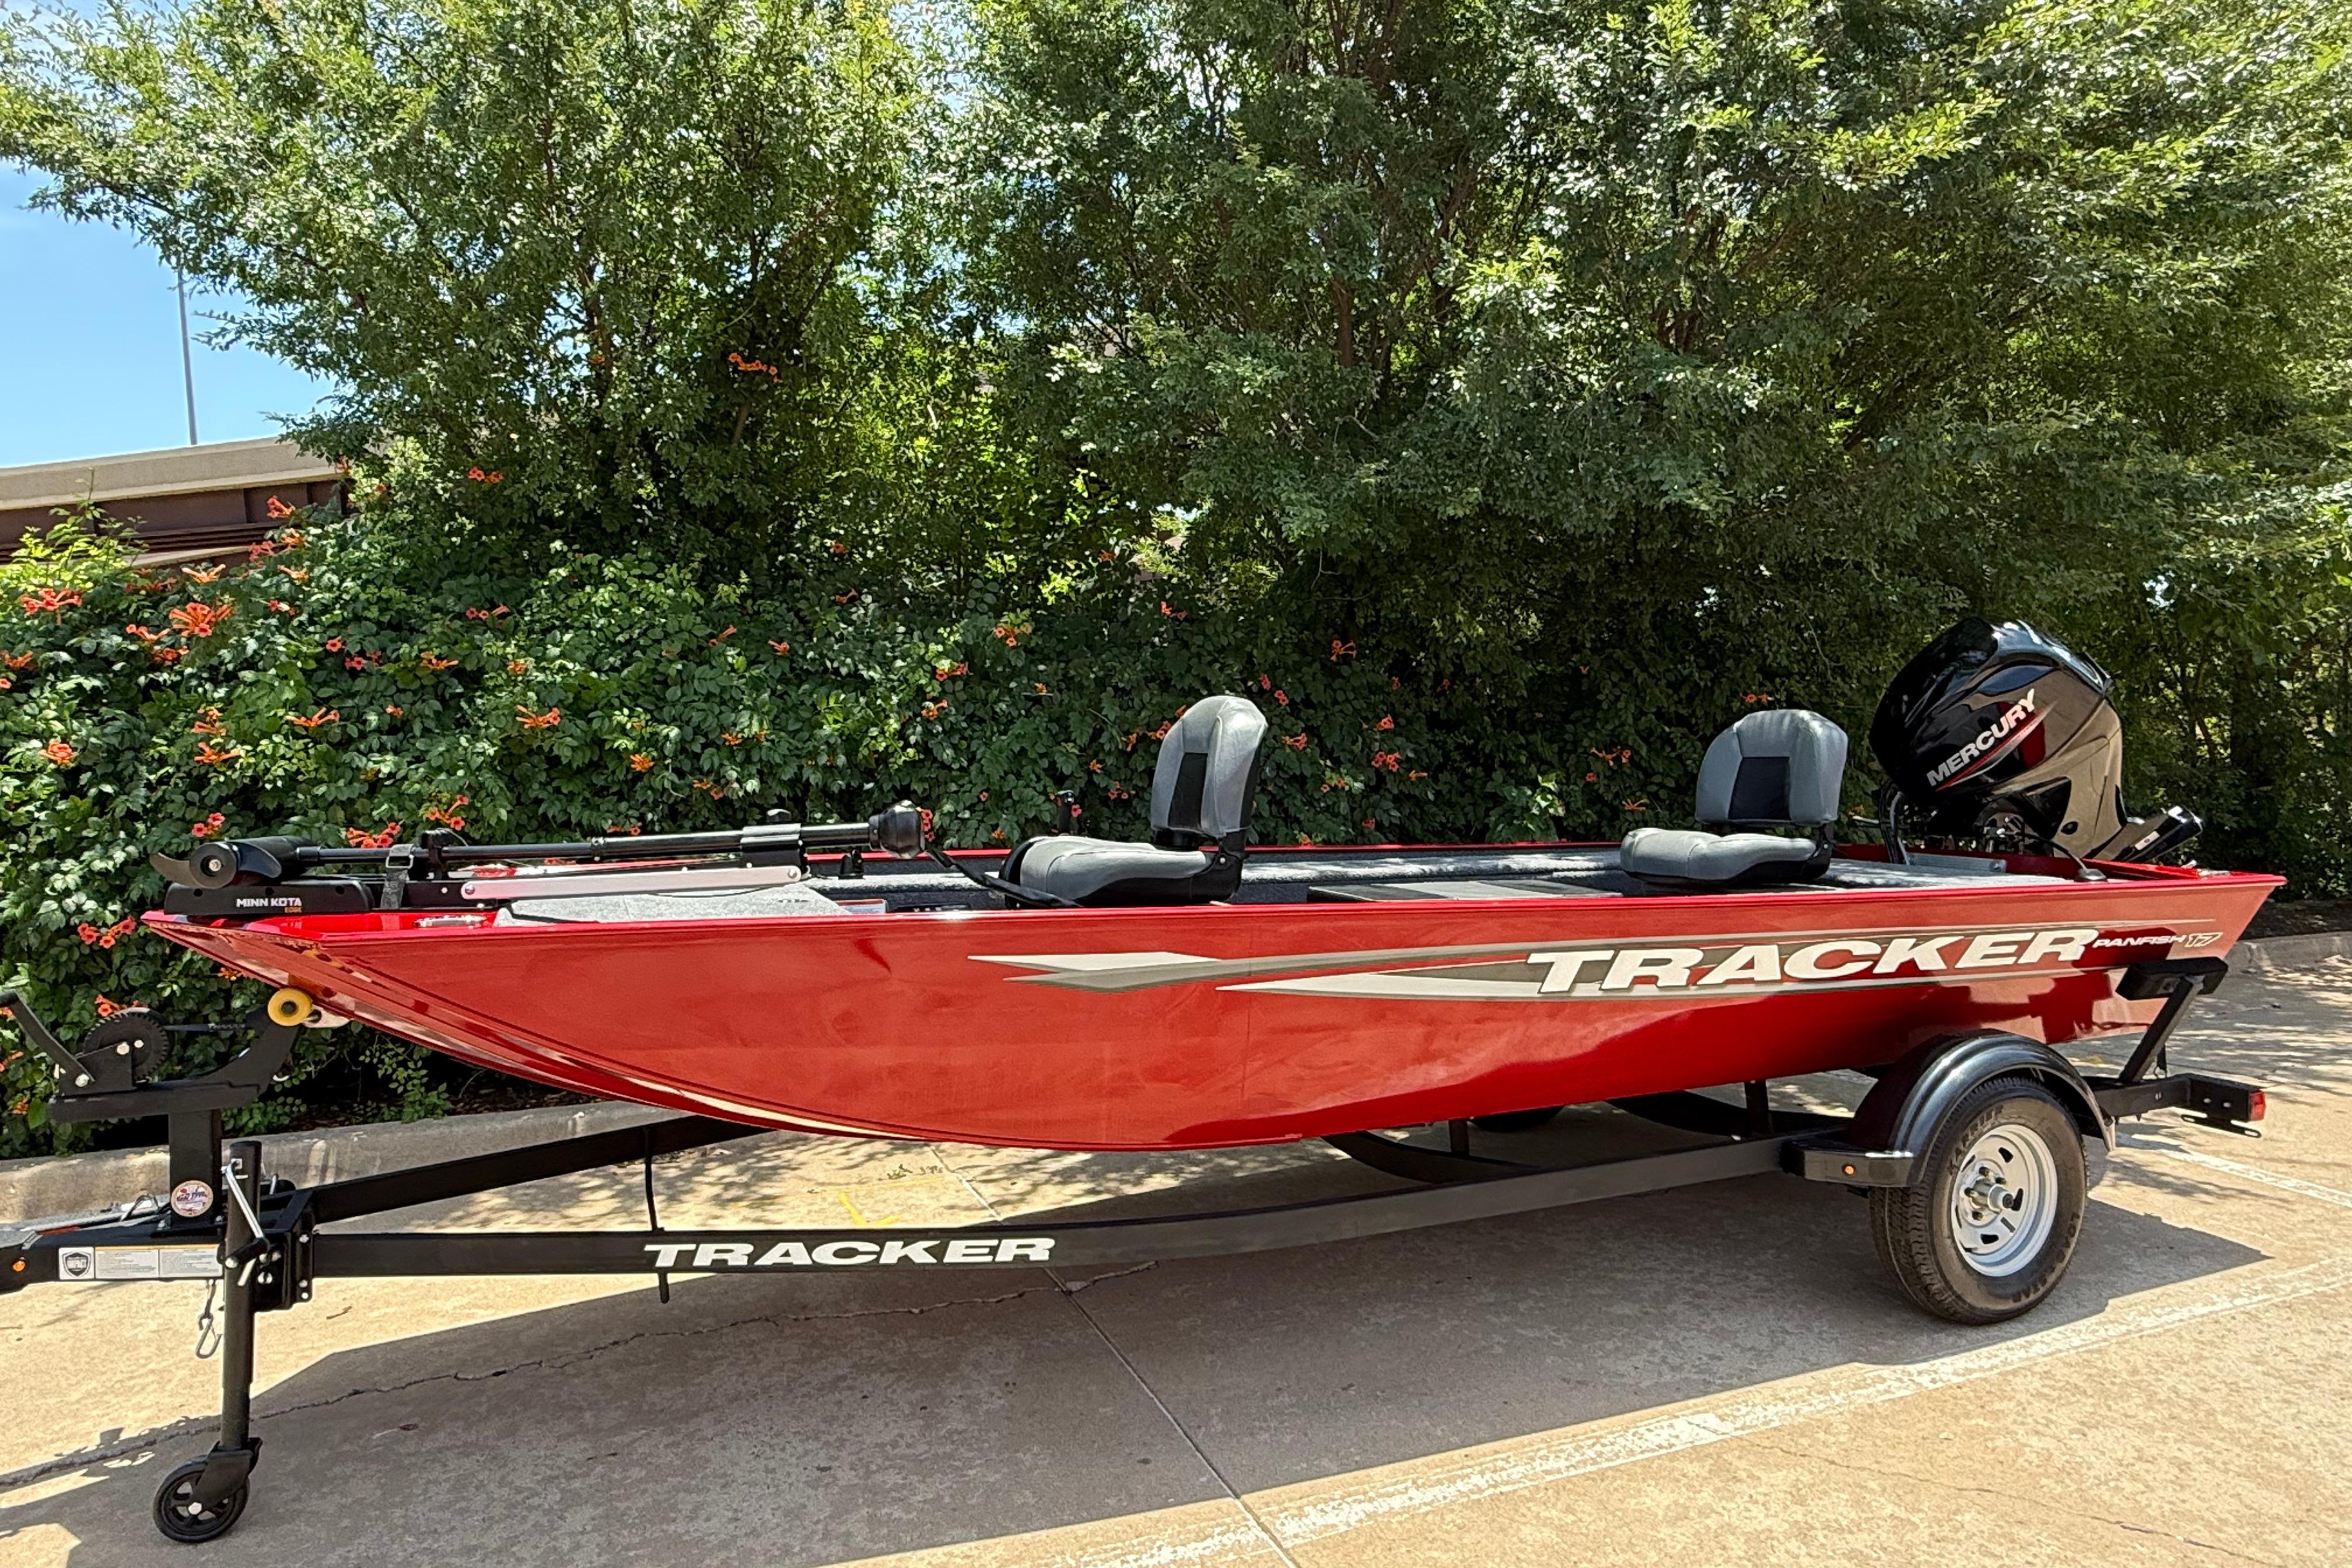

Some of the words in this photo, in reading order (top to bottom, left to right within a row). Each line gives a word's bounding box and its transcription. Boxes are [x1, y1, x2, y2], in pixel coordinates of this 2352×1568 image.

[1926, 688, 2035, 786] MERCURY
[236, 898, 268, 908] MINN
[270, 897, 302, 907] KOTA
[1527, 929, 2098, 993] TRACKER
[2092, 935, 2187, 948] PANFISH
[2185, 932, 2224, 947] 17
[644, 1238, 1056, 1267] TRACKER
